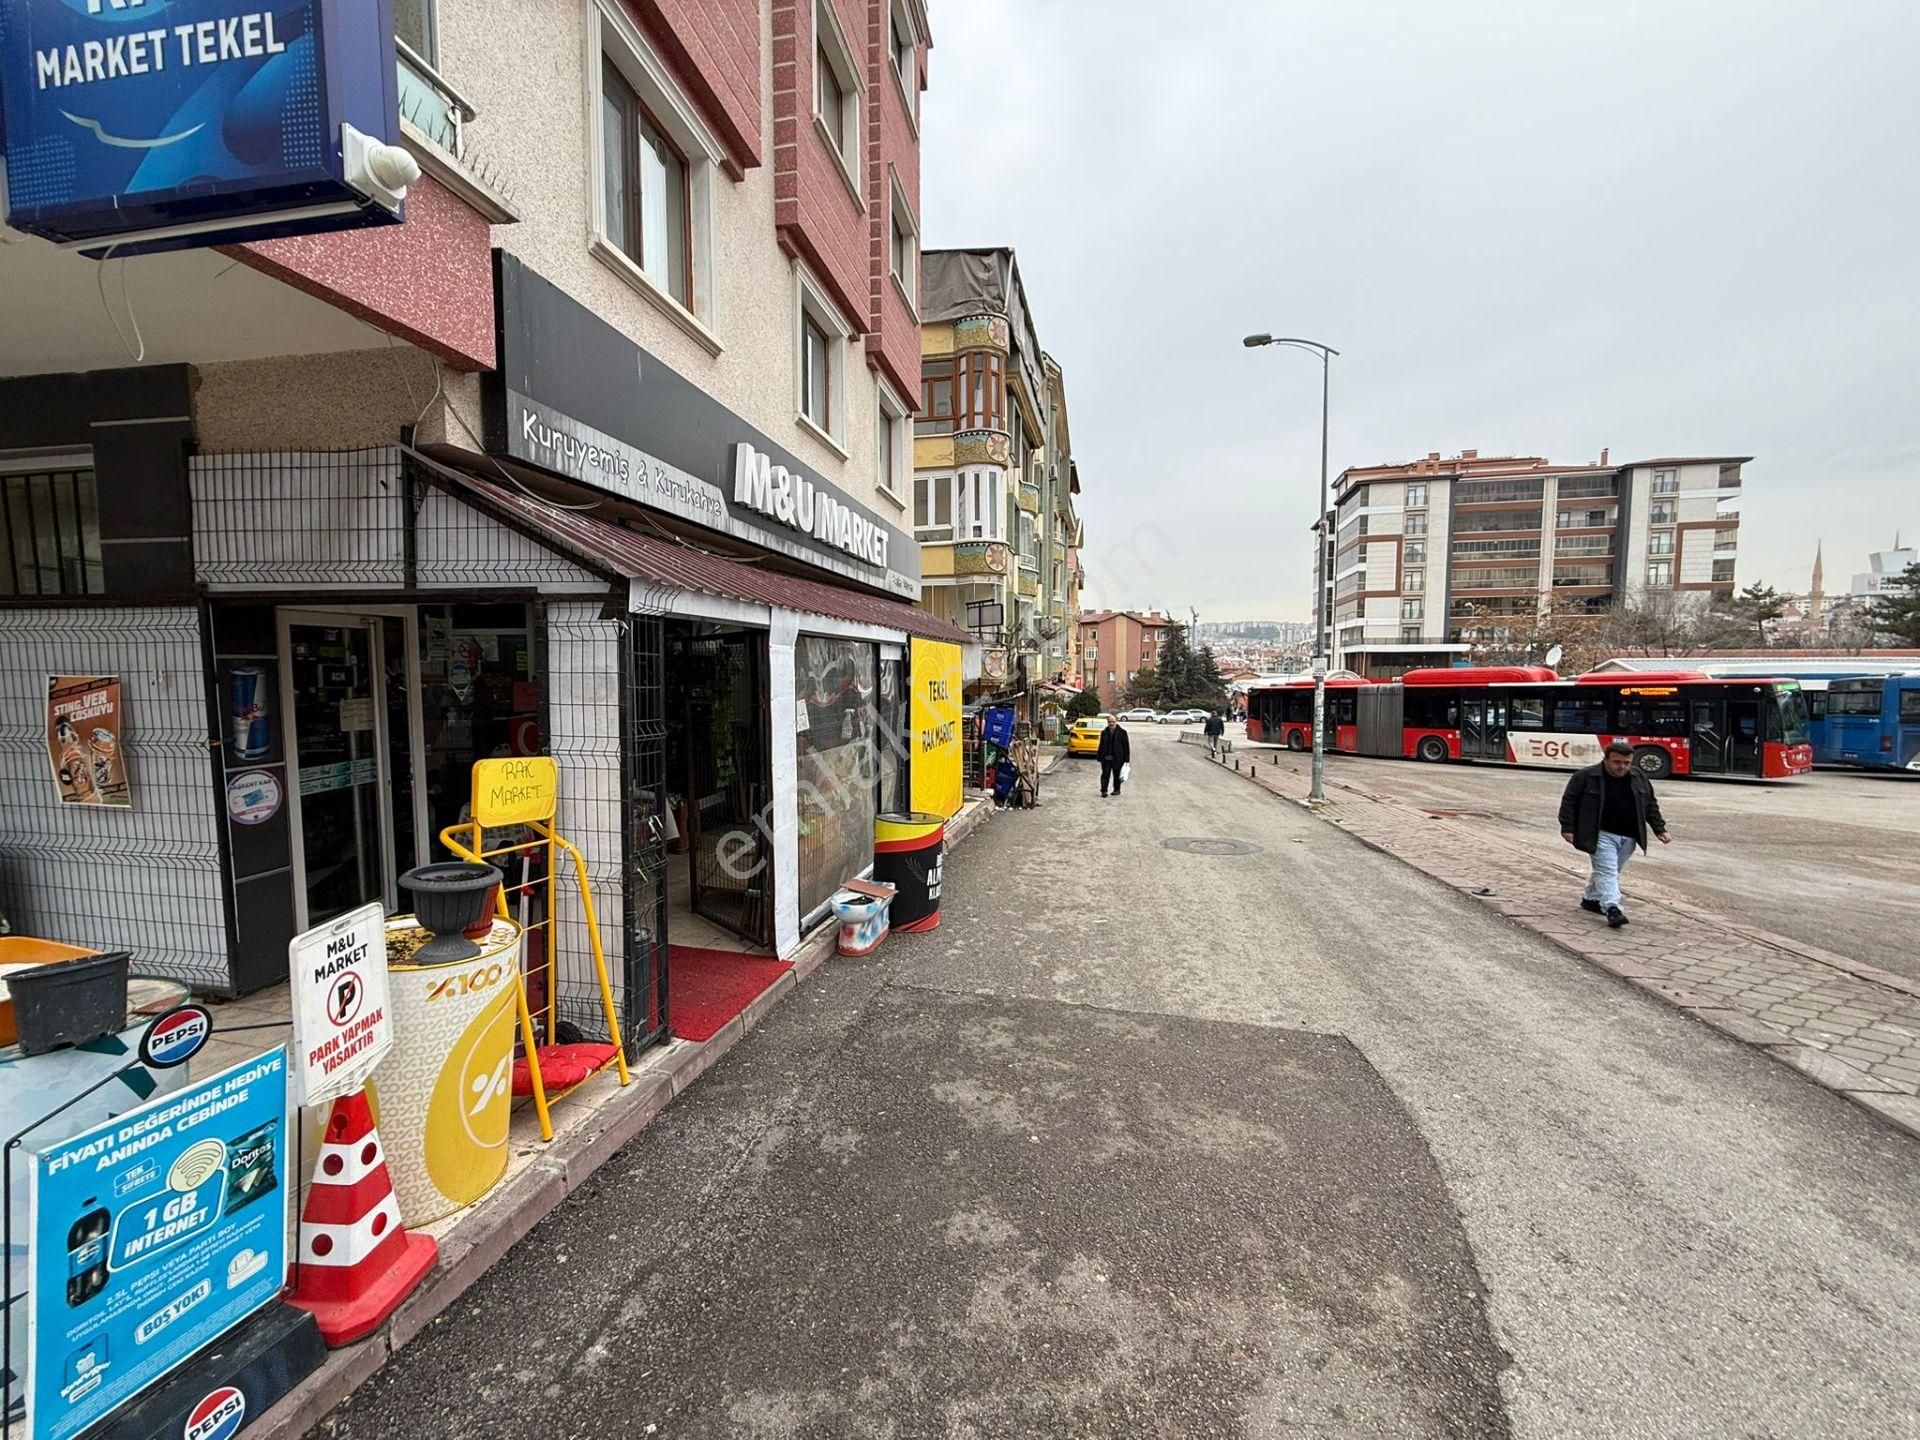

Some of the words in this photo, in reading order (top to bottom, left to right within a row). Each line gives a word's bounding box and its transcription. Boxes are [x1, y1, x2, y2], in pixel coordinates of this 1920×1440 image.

[36, 28, 167, 90] MARKET
[174, 12, 286, 66] TEKEL
[523, 408, 629, 485] Kuruyemiş
[636, 460, 649, 488] &
[655, 467, 722, 516] Kurukahve
[734, 442, 814, 533] M&U
[814, 491, 889, 569] MARKET
[928, 680, 949, 702] TEKEL
[921, 729, 935, 754] RAK
[935, 720, 956, 748] MARKET
[501, 760, 535, 780] RAK
[490, 784, 543, 809] MARKET
[314, 943, 369, 984] MARKET
[326, 932, 356, 959] M&U
[152, 1022, 204, 1050] PEPSI
[309, 1035, 341, 1067] PARK
[341, 1007, 384, 1042] YAPMAK
[322, 1030, 374, 1076] YASAKTIR
[48, 1136, 116, 1176] FİYATI
[118, 1084, 222, 1144] DEĞERİNDE
[224, 1058, 283, 1094] HEDİYE
[95, 1126, 173, 1173] ANINDA
[176, 1089, 249, 1132] CEBİNDE
[125, 1165, 145, 1180] TEK
[231, 1141, 272, 1171] Doritos
[144, 1207, 158, 1231] 1
[162, 1190, 198, 1223] GB
[130, 1266, 160, 1291] PEPSI
[162, 1250, 187, 1272] VEYA
[142, 1309, 172, 1338] BOŞ
[174, 1285, 206, 1315] YOK!
[188, 1396, 242, 1440] PEPSI
